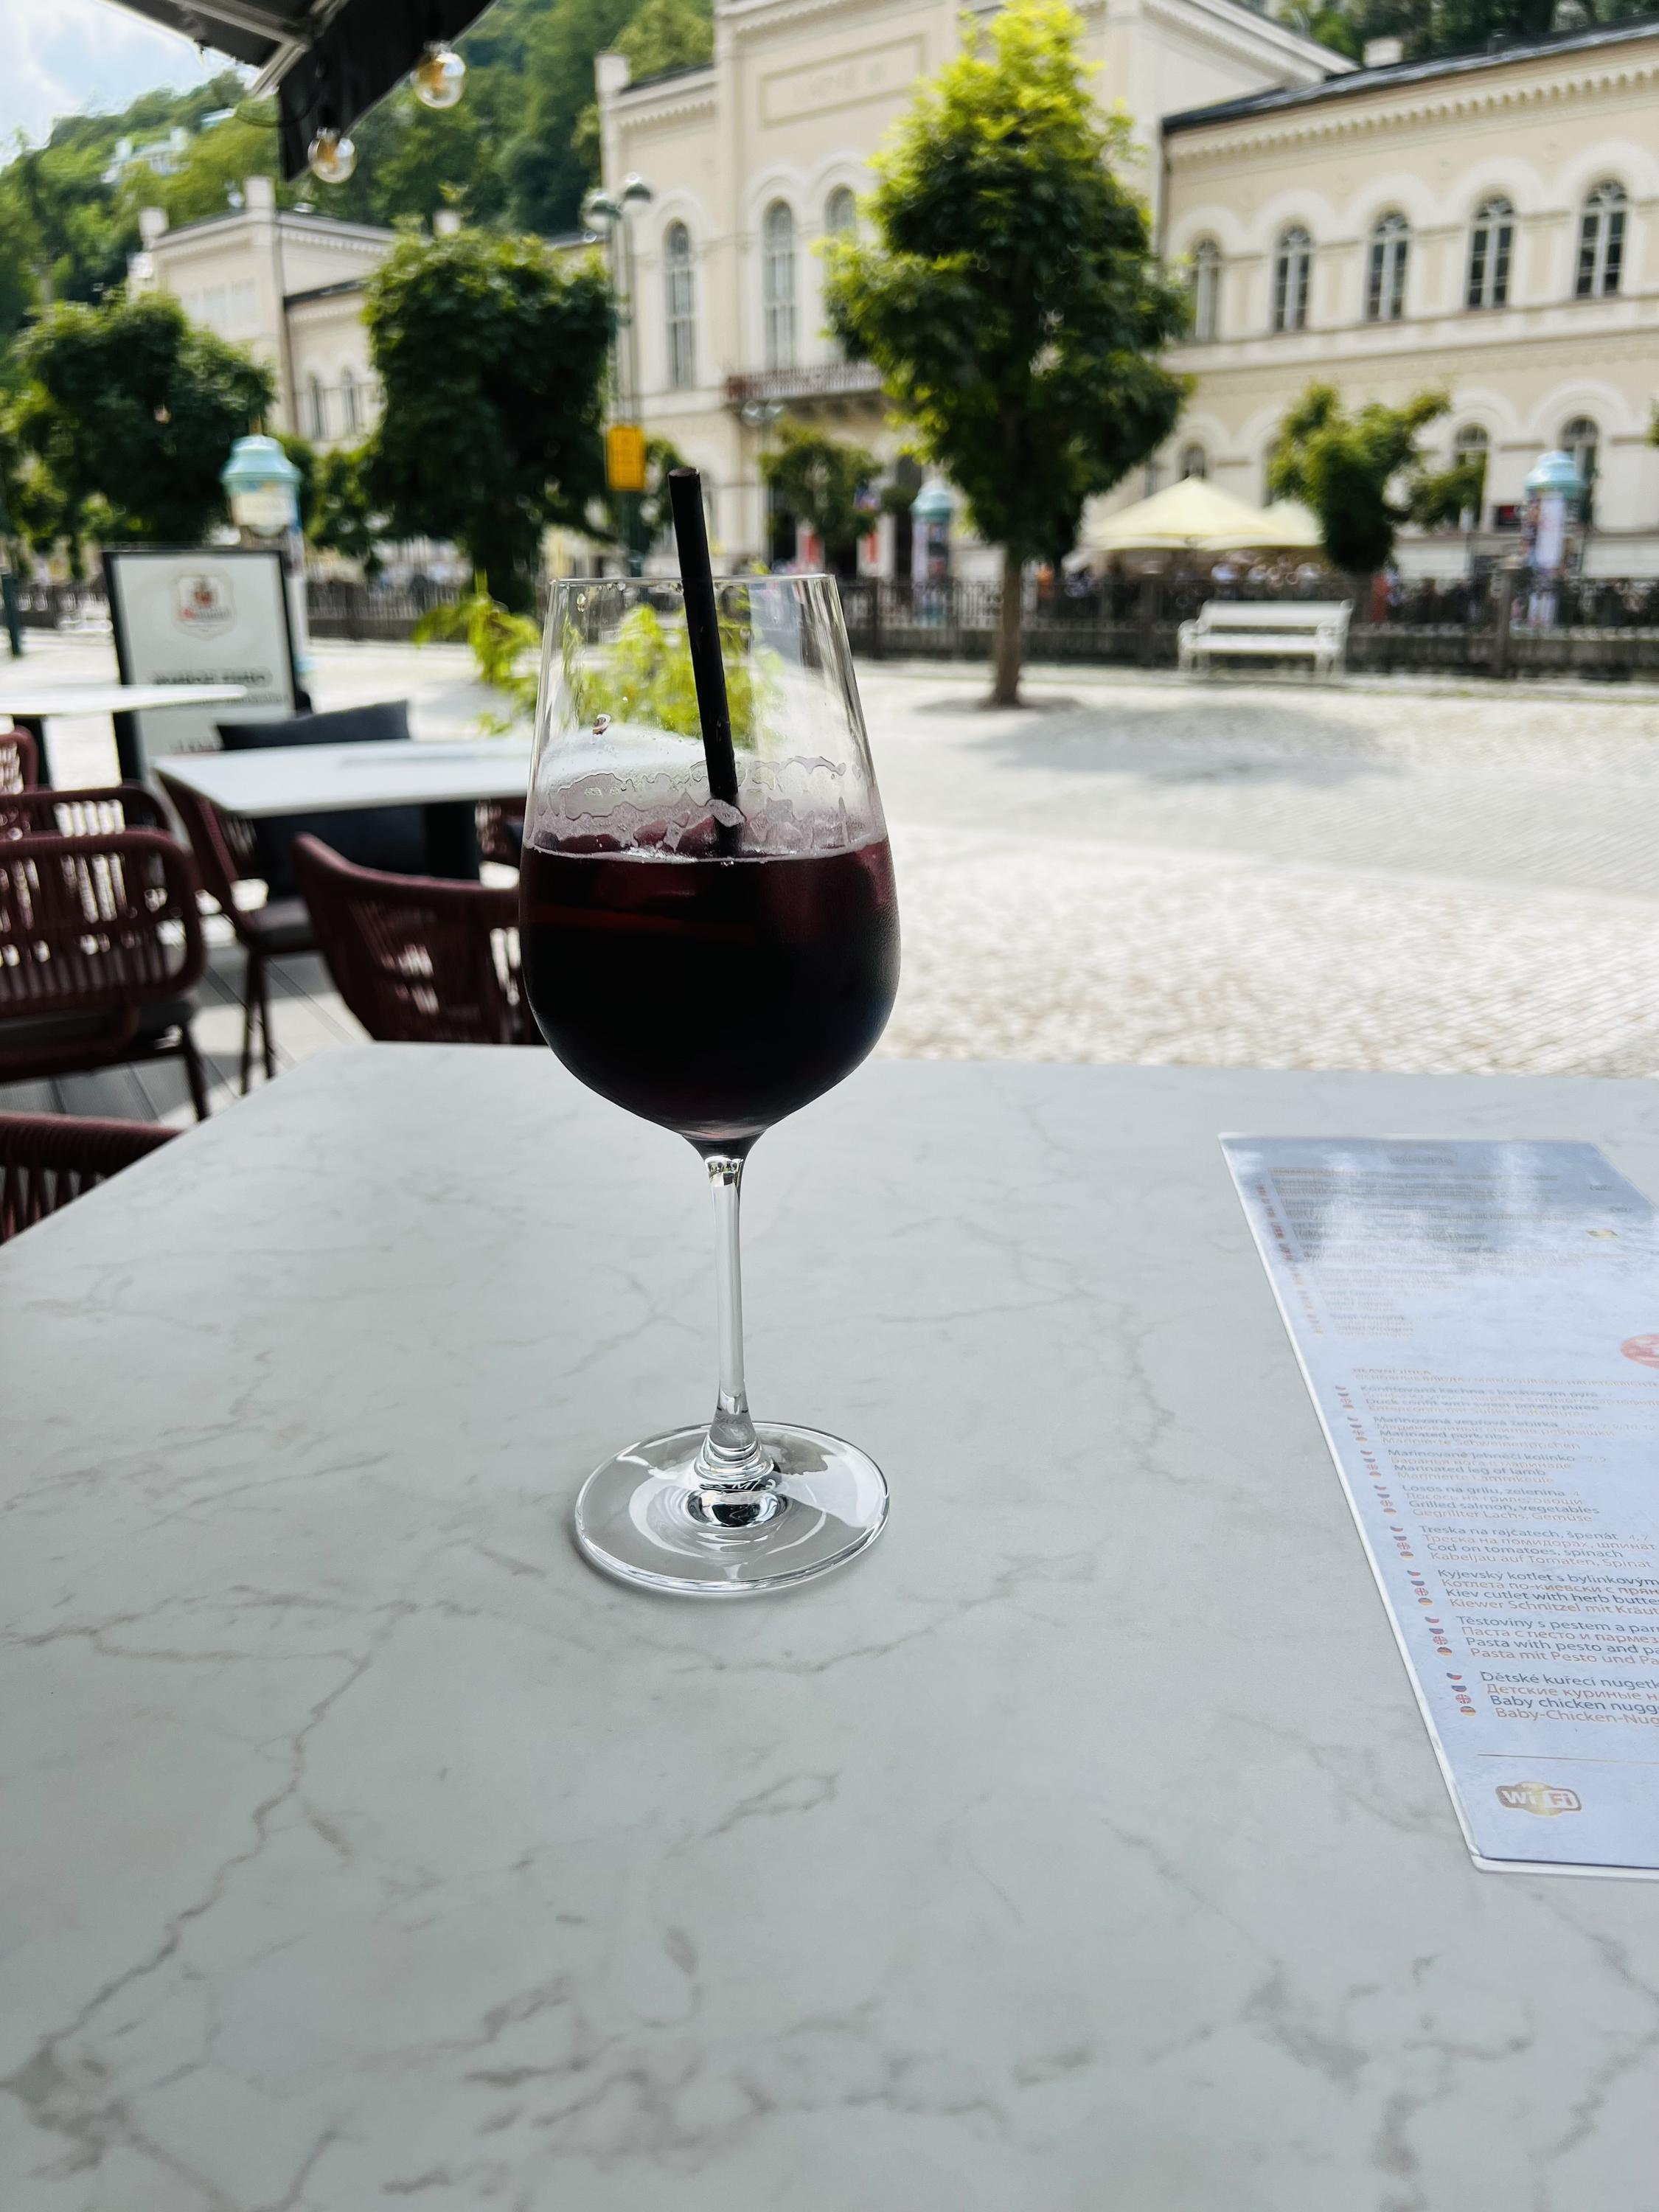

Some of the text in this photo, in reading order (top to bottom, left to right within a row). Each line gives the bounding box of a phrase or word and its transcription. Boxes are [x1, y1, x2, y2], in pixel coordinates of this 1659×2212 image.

[1393, 1464, 1464, 1472] Marinated
[1467, 1467, 1490, 1475] leg
[1506, 1489, 1565, 1497] zelenina
[1409, 1500, 1600, 1514] Grilled salmon, vegetables
[1418, 1525, 1466, 1534] Treska
[1492, 1528, 1565, 1539] rajčatech,
[1568, 1530, 1619, 1541] špenát
[1422, 1534, 1475, 1545] Треска
[1427, 1543, 1456, 1552] Cod
[1484, 1545, 1561, 1557] tomatoes,
[1564, 1549, 1624, 1559] spinach
[1430, 1552, 1653, 1569] Kabeljau auf Tomaten, Spinat
[1437, 1569, 1659, 1587] Kyjevský kotlet s bylinkovým
[1441, 1579, 1505, 1590] Котлета
[1509, 1583, 1602, 1593] по-киевски
[1445, 1588, 1479, 1598] Kiev
[1484, 1590, 1530, 1600] cutlet
[1532, 1591, 1568, 1601] with
[1571, 1593, 1610, 1603] herb
[1450, 1599, 1504, 1608] Kiewer
[1509, 1600, 1582, 1613] Schnitzel
[1585, 1604, 1614, 1613] mit
[1455, 1615, 1534, 1630] Těstoviny
[1548, 1621, 1611, 1631] pestem
[1628, 1625, 1659, 1634] par
[1461, 1627, 1511, 1637] Паста
[1527, 1630, 1576, 1640] песто
[1465, 1637, 1511, 1648] Pasta
[1513, 1639, 1552, 1650] with
[1555, 1641, 1602, 1652] pesto
[1605, 1644, 1639, 1654] and
[1470, 1647, 1515, 1659] Pasta
[1519, 1650, 1550, 1660] mit
[1551, 1651, 1598, 1663] Pesto
[1601, 1655, 1636, 1664] und
[1479, 1671, 1540, 1684] Dětské
[1543, 1674, 1597, 1686] kuřecí
[1486, 1684, 1559, 1697] Детские
[1562, 1689, 1643, 1700] куриные
[1489, 1695, 1659, 1715] Baby chicken nugg
